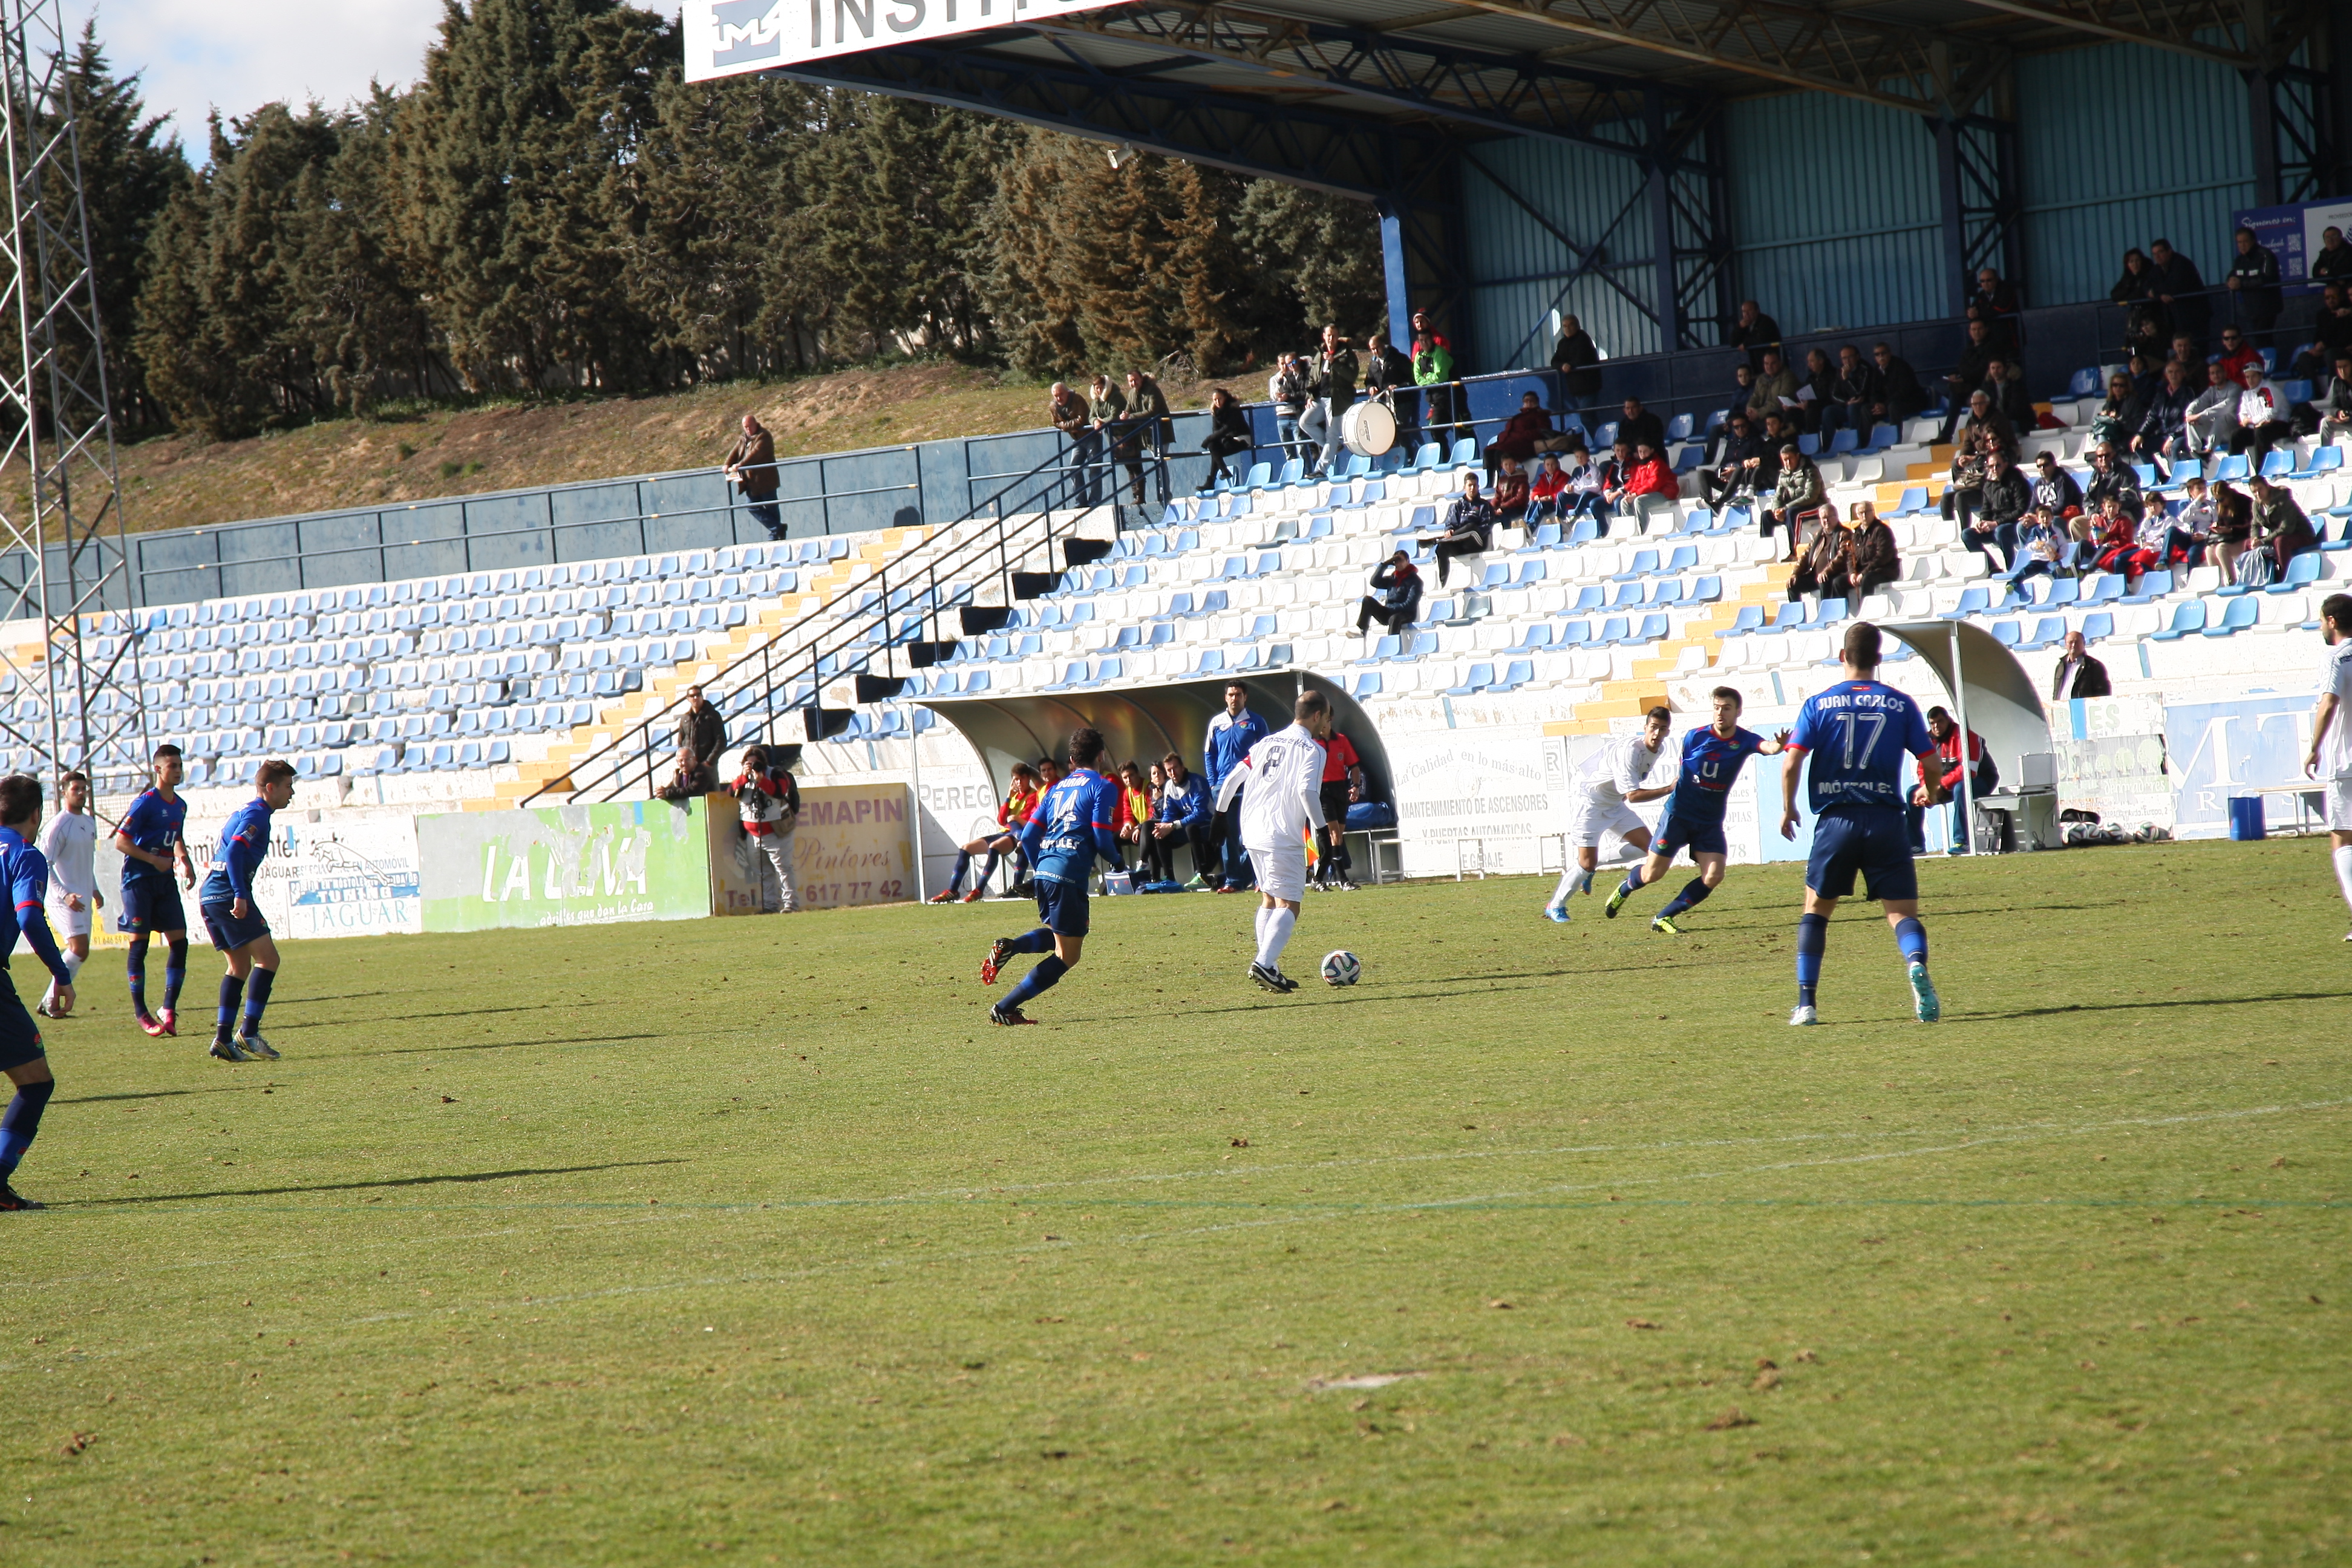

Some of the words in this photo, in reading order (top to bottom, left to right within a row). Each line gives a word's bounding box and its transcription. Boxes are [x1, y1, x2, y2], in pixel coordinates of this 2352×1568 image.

[1817, 694, 1851, 711] JUAN
[1855, 694, 1906, 713] CARLOS
[1836, 712, 1887, 769] 17
[1263, 745, 1286, 782] 8
[1395, 772, 1410, 787] La
[1411, 748, 1454, 779] Calidad
[1460, 750, 1474, 763] en
[1478, 751, 1488, 766] lo
[1491, 758, 1515, 774] más
[1518, 764, 1541, 780] alto
[1056, 775, 1091, 790] DURÁN
[1052, 789, 1077, 832] 14
[1401, 798, 1472, 819] MANTENIMIENTO
[1474, 797, 1486, 814] DE
[1488, 793, 1548, 814] ASCENSORES
[1422, 828, 1428, 846] Y
[1429, 826, 1468, 845] PUERTAS
[1471, 822, 1532, 842] AUTOMATICAS
[793, 836, 891, 871] Pintores
[1730, 843, 1747, 858] 78
[260, 866, 299, 879] JAGUAR
[482, 845, 531, 902] LA
[806, 883, 841, 902] 617
[848, 881, 872, 900] 77
[879, 878, 903, 898] 42
[312, 900, 409, 933] JAGUAR
[630, 898, 654, 913] Cara
